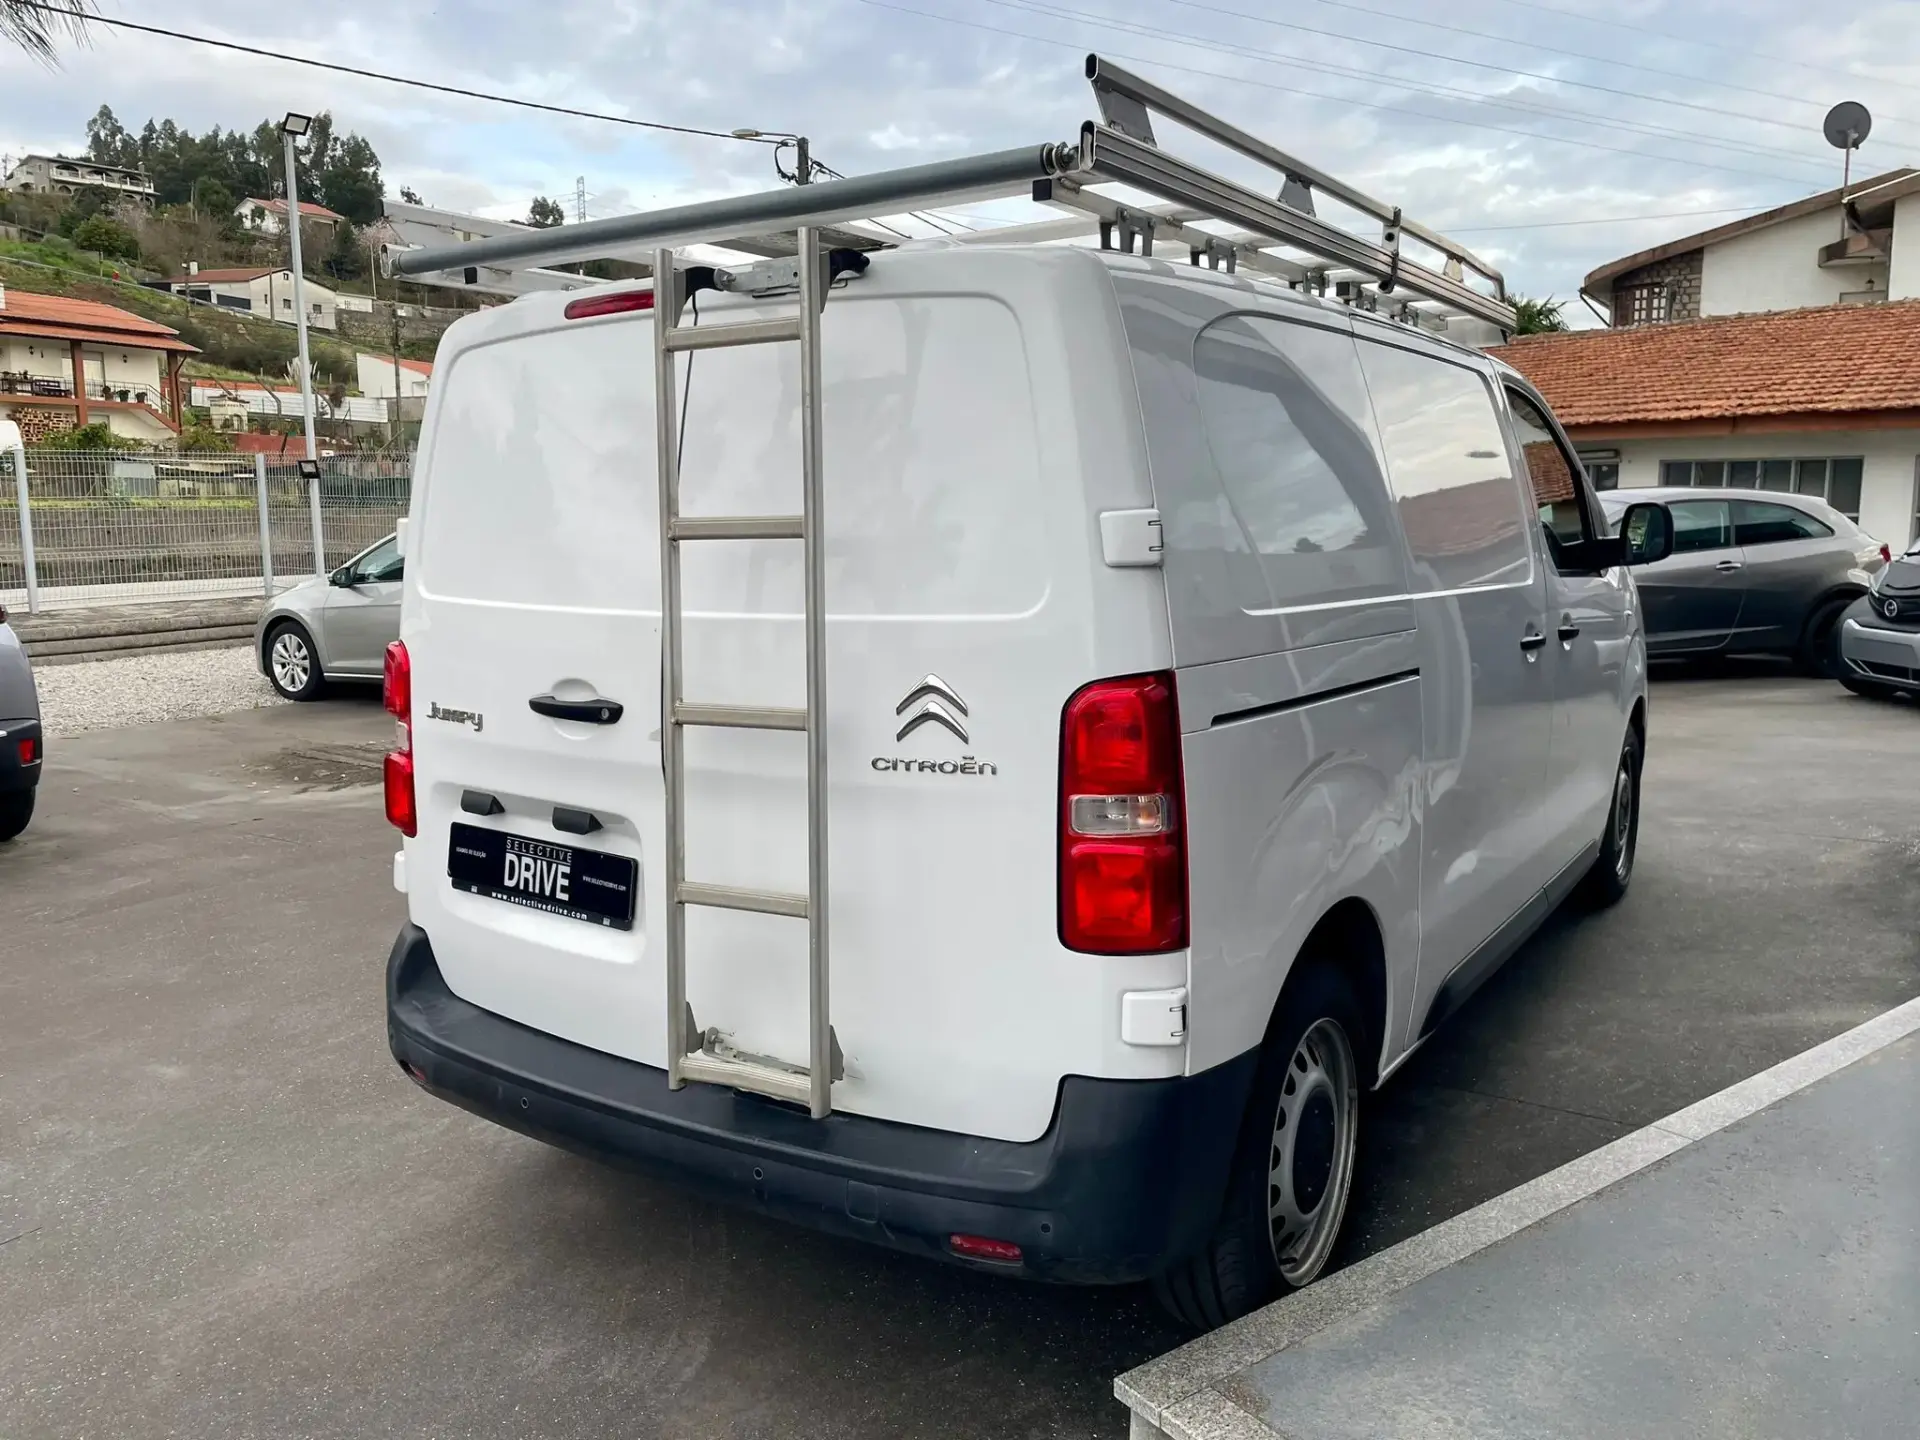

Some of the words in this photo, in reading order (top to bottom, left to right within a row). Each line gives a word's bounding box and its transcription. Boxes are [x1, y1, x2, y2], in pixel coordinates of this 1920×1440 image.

[506, 839, 572, 863] SELECTIVE
[504, 852, 571, 901] DRIVE
[492, 891, 588, 920] www.selectivedrive.com
